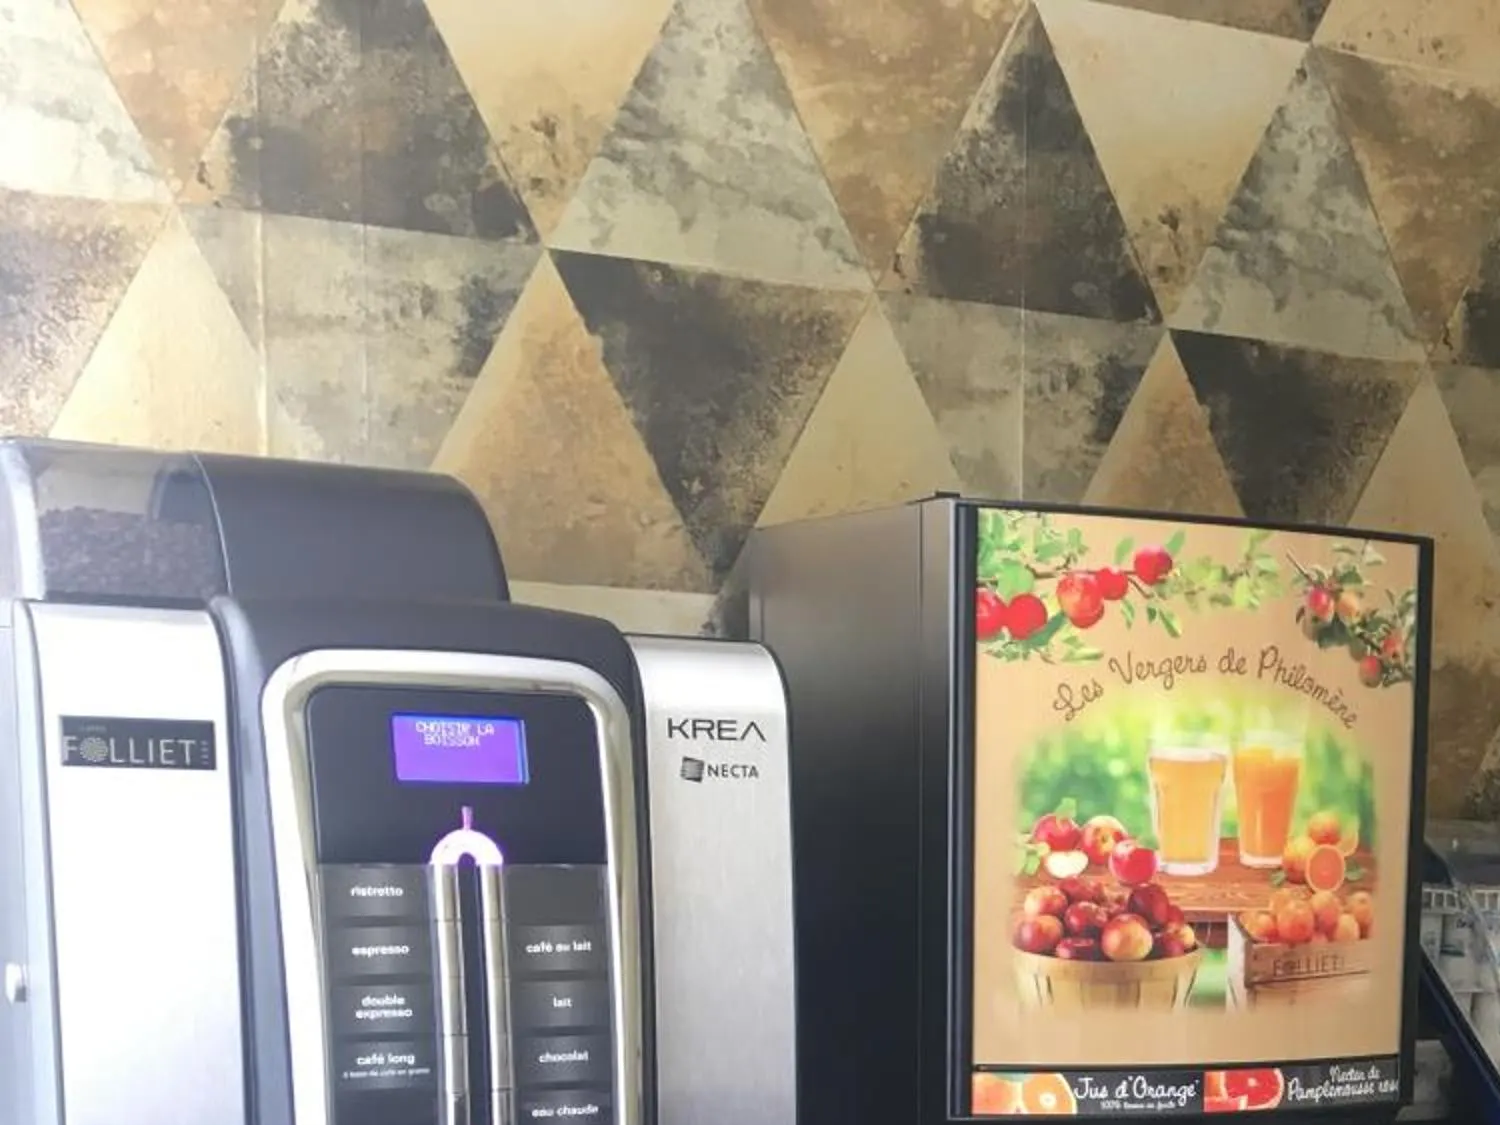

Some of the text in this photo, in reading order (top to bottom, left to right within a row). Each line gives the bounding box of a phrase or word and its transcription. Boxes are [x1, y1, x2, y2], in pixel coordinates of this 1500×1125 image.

[1053, 645, 1358, 730] Les Vergers de Philomène
[477, 723, 495, 736] LA
[707, 763, 759, 779] NECTA
[350, 885, 404, 897] ristretto
[525, 939, 592, 954] café au lait
[361, 993, 406, 1007] double
[553, 995, 573, 1008] lait
[356, 1052, 416, 1066] café long
[538, 1049, 589, 1063] chocolat
[1073, 1077, 1109, 1100] Jus
[556, 1103, 599, 1117] chaude
